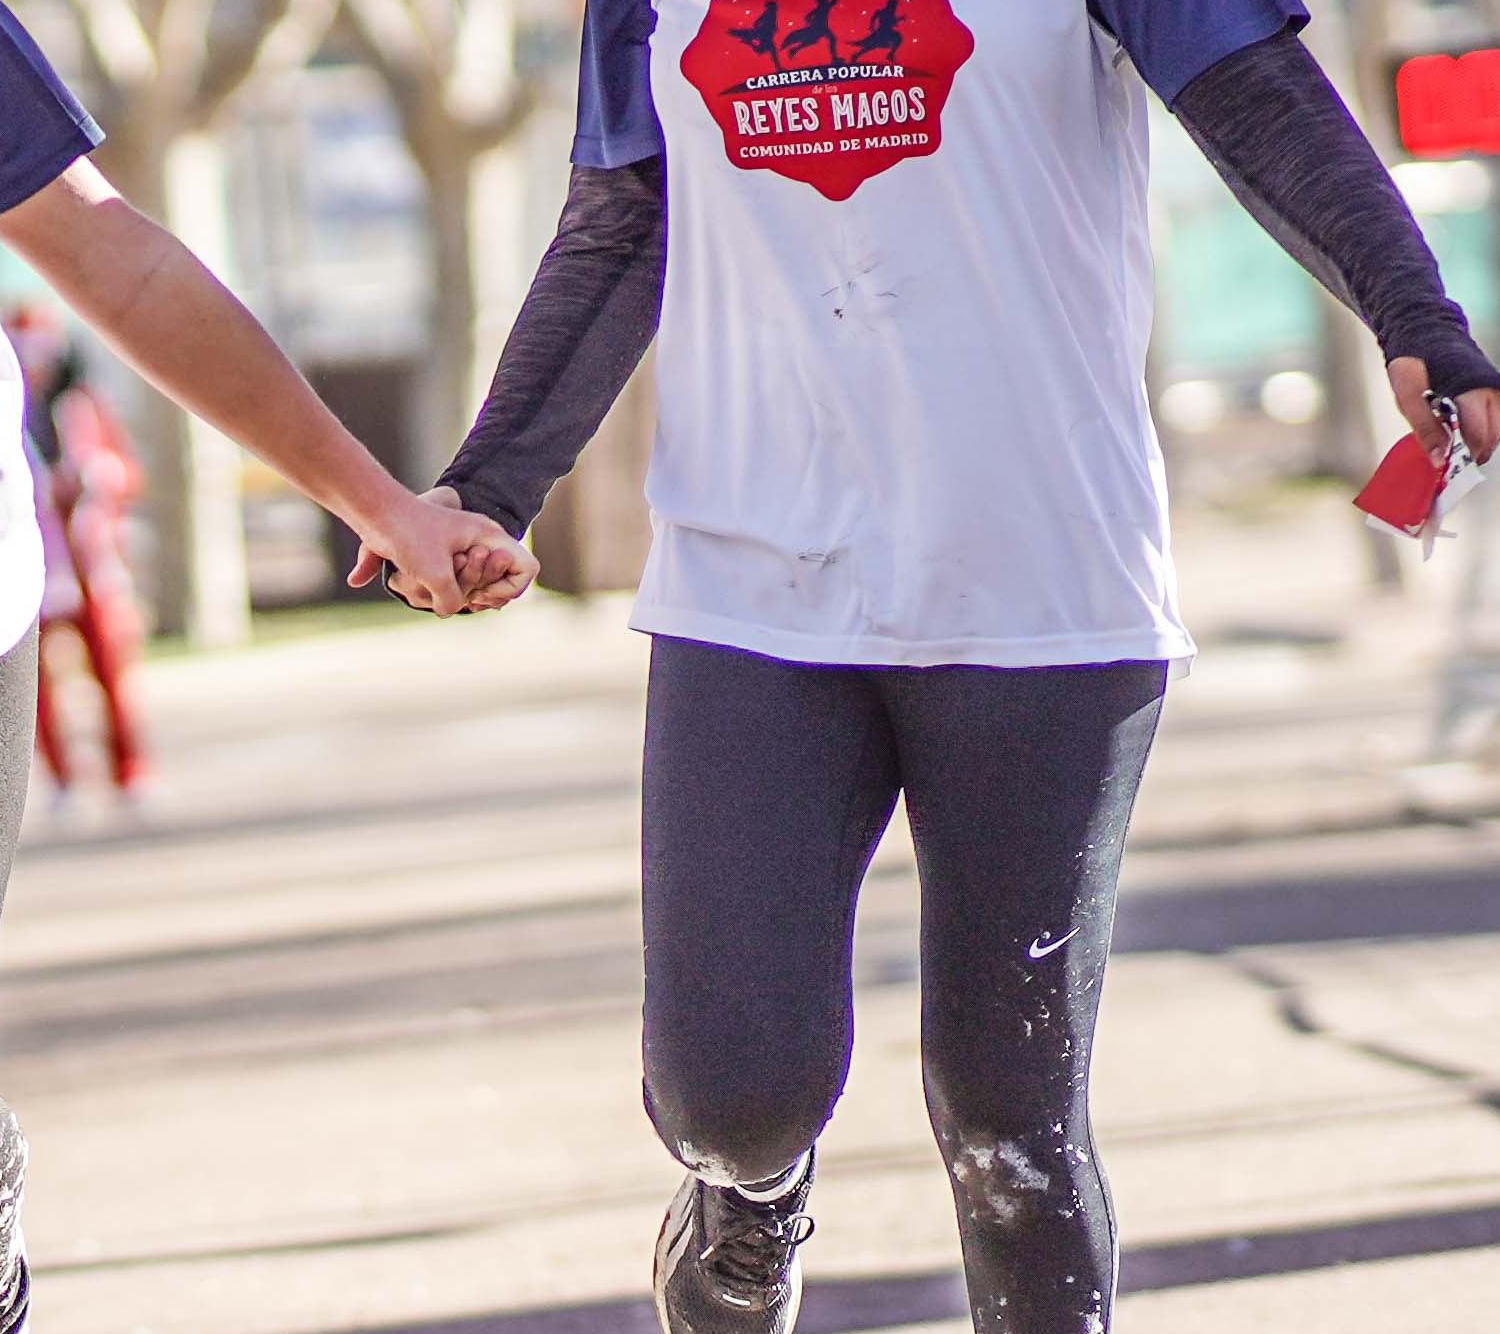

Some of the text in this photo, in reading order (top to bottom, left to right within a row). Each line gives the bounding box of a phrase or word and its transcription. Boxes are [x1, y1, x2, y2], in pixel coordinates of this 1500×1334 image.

[746, 65, 904, 90] CARRERA POPULAR
[733, 86, 926, 136] REYES MAGOS
[740, 133, 929, 158] COMUNIDAD DE MADRID
